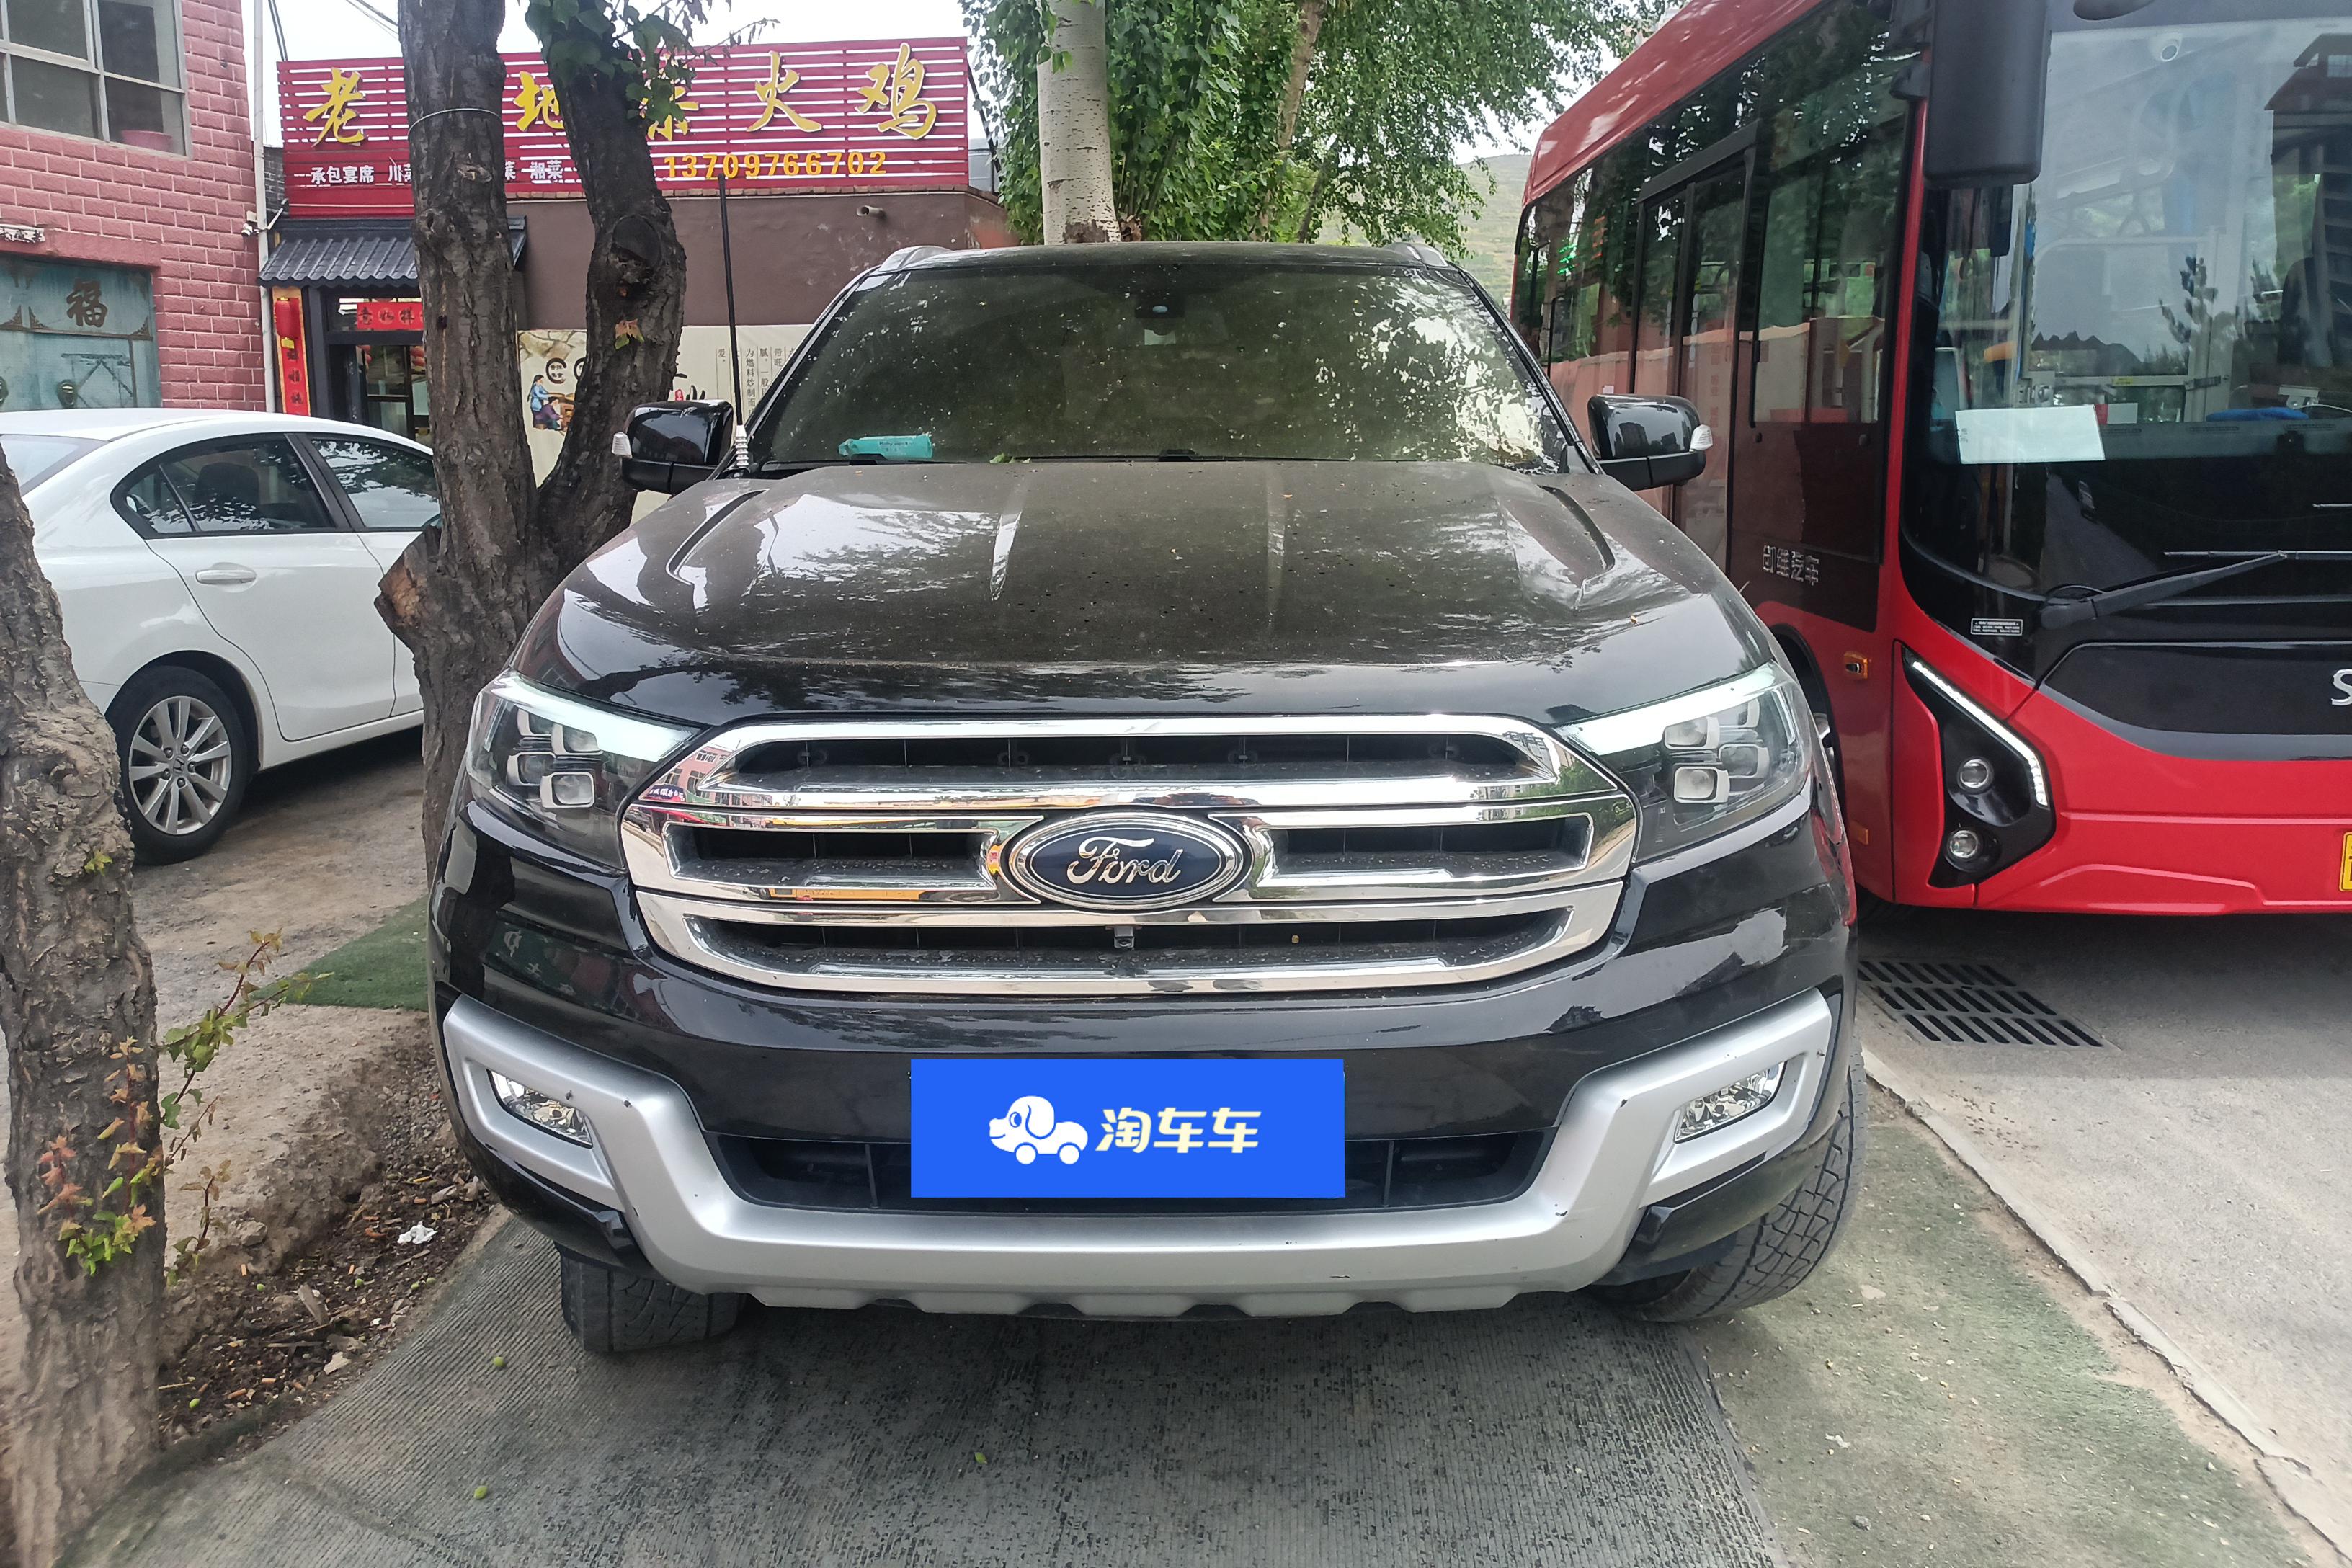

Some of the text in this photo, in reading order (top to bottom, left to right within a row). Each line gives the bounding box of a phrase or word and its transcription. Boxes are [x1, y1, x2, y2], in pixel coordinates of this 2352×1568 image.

[311, 164, 375, 184] 承包宴席
[530, 159, 563, 179] 湘菜
[664, 151, 888, 180] 13709766702
[66, 277, 108, 328] 福
[1066, 836, 1184, 885] Ford
